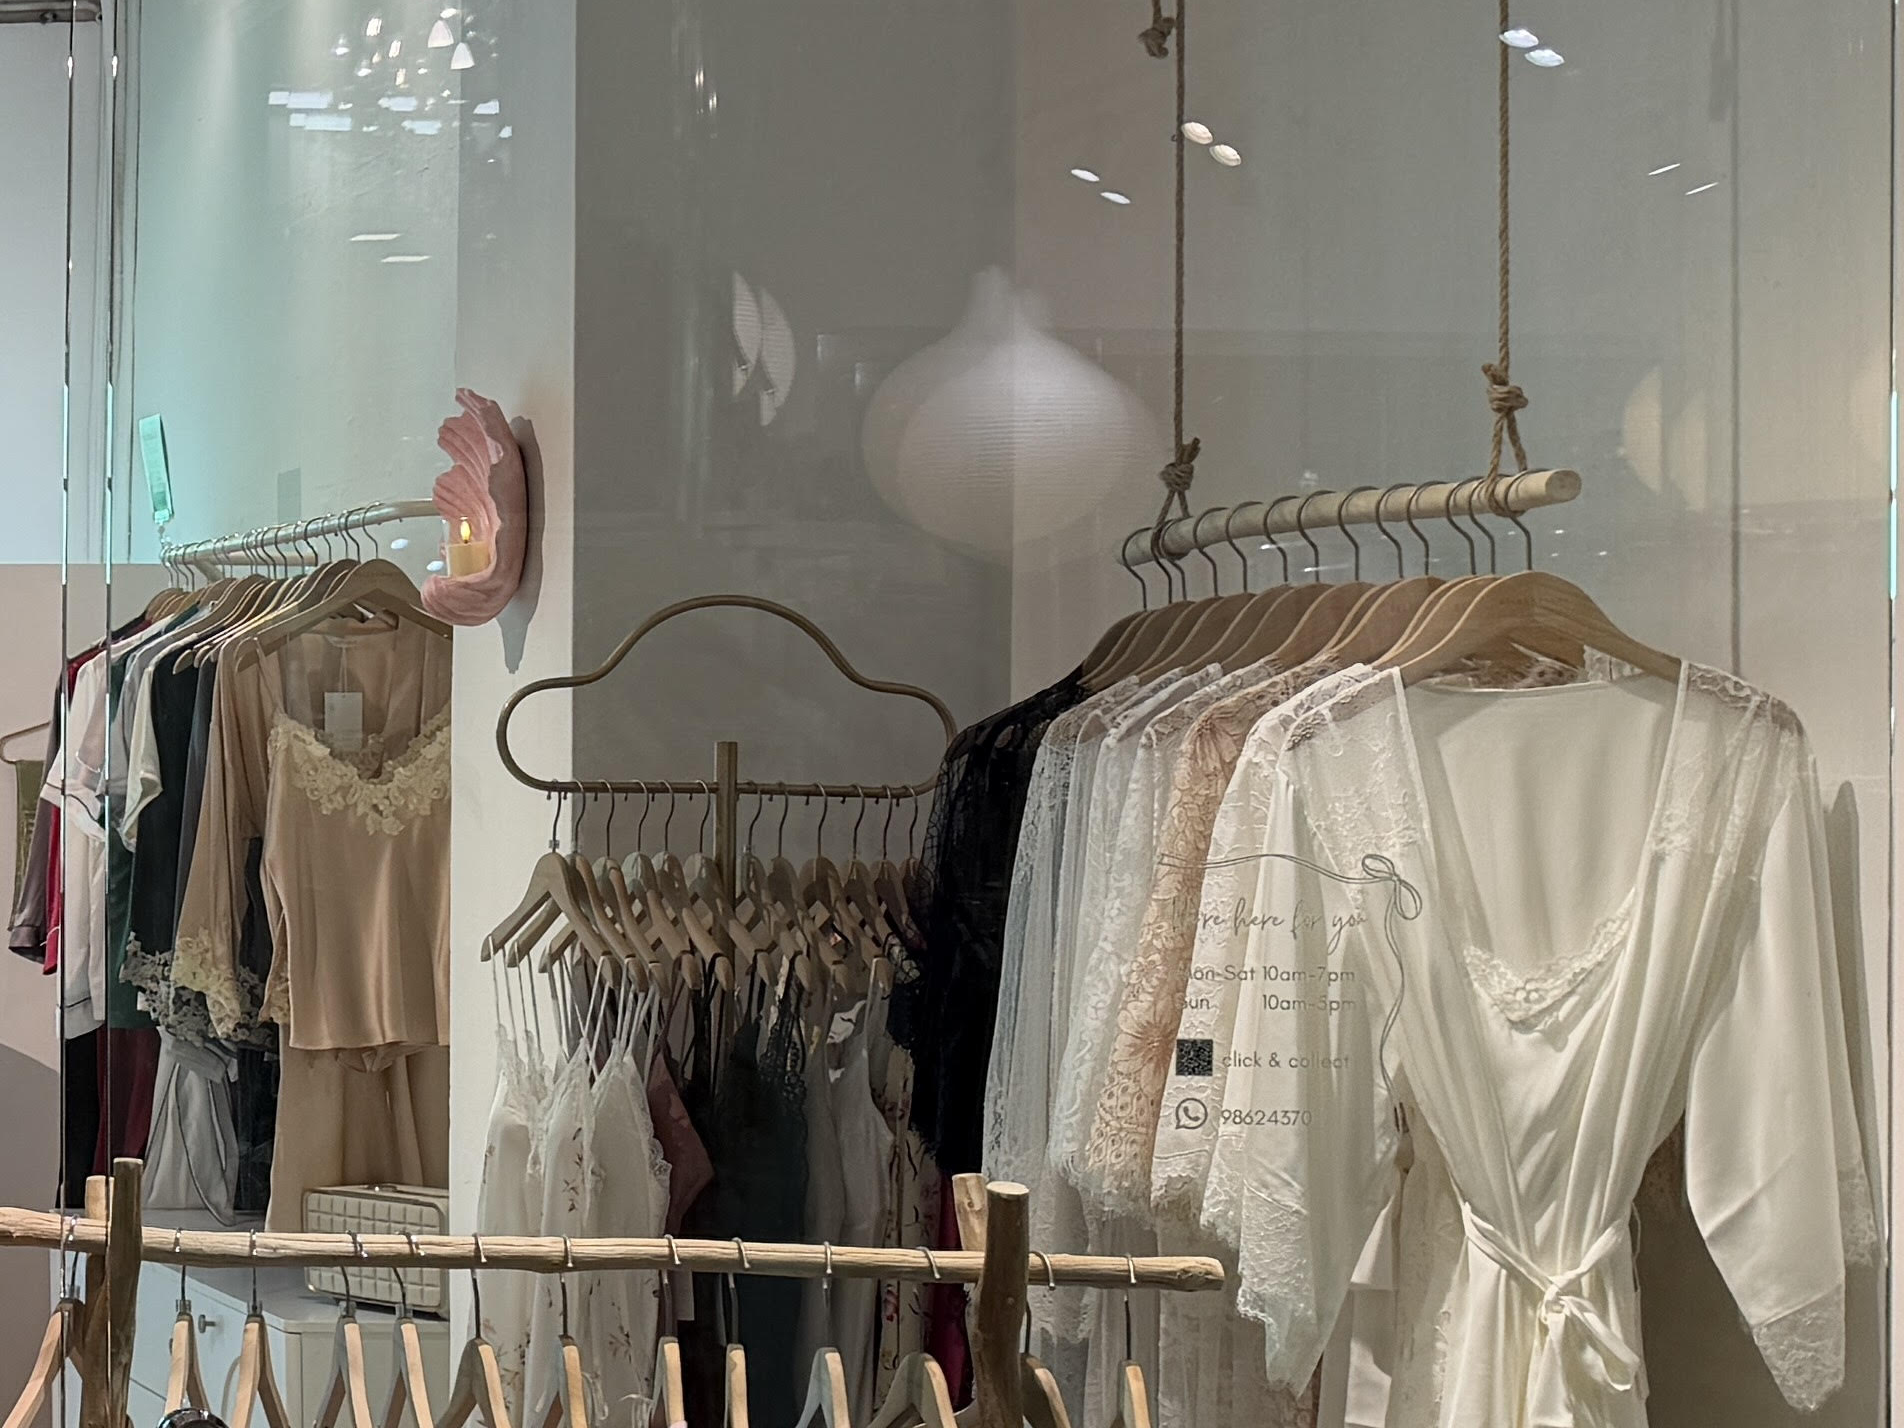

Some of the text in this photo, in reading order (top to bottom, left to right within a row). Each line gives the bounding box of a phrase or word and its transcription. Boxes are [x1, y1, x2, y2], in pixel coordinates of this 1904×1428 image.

[1234, 897, 1284, 936] here
[1291, 899, 1323, 940] for
[1327, 912, 1368, 955] you
[1262, 965, 1356, 986] 10am-7pm
[1222, 1050, 1350, 1070] click & collect
[1220, 1109, 1313, 1127] 98624370
